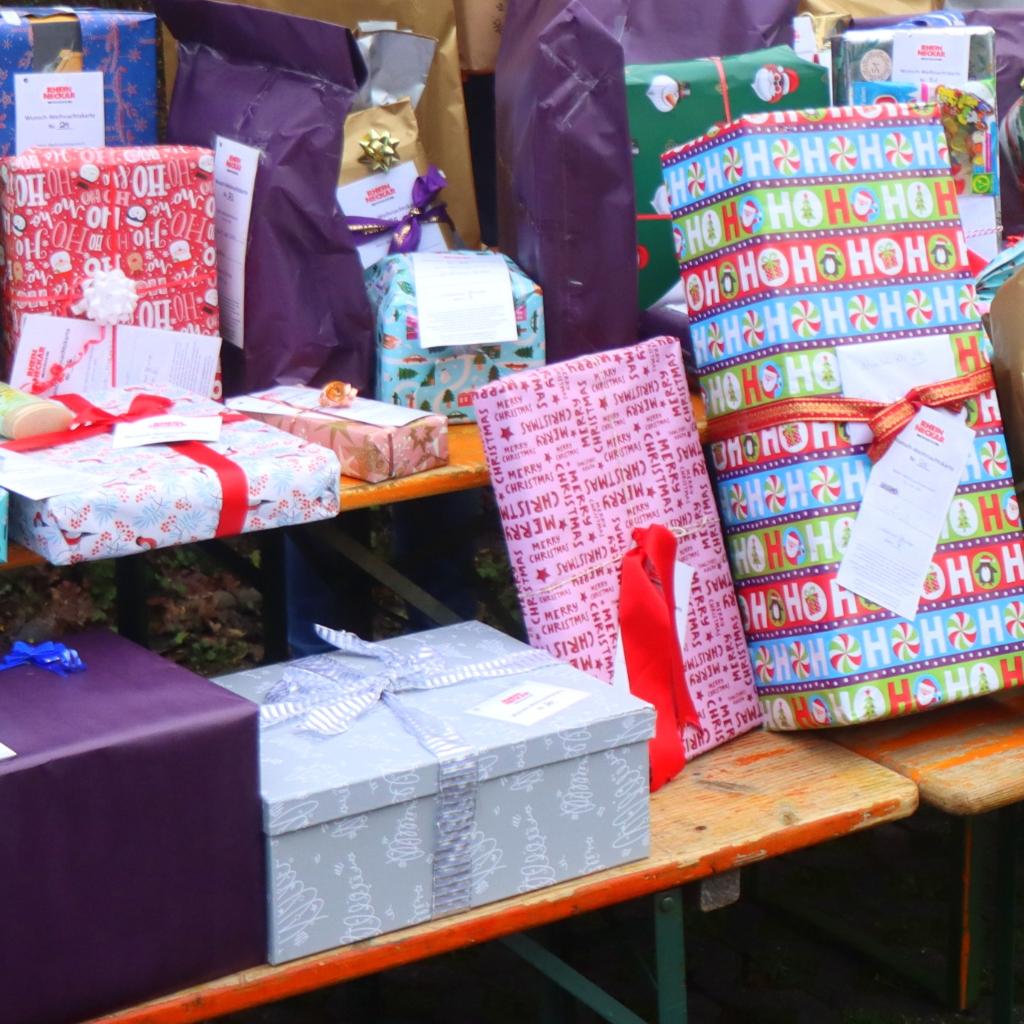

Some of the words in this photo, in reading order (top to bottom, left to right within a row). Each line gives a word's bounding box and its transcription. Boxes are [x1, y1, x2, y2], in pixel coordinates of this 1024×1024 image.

[917, 49, 944, 57] NECKAR
[921, 44, 942, 52] RHEIN
[46, 86, 72, 94] RHEIN
[43, 92, 75, 100] NECKAR
[365, 183, 391, 196] RHEIN
[364, 187, 395, 203] NECKAR
[919, 420, 944, 436] RHEIN
[914, 424, 945, 443] NECKAR
